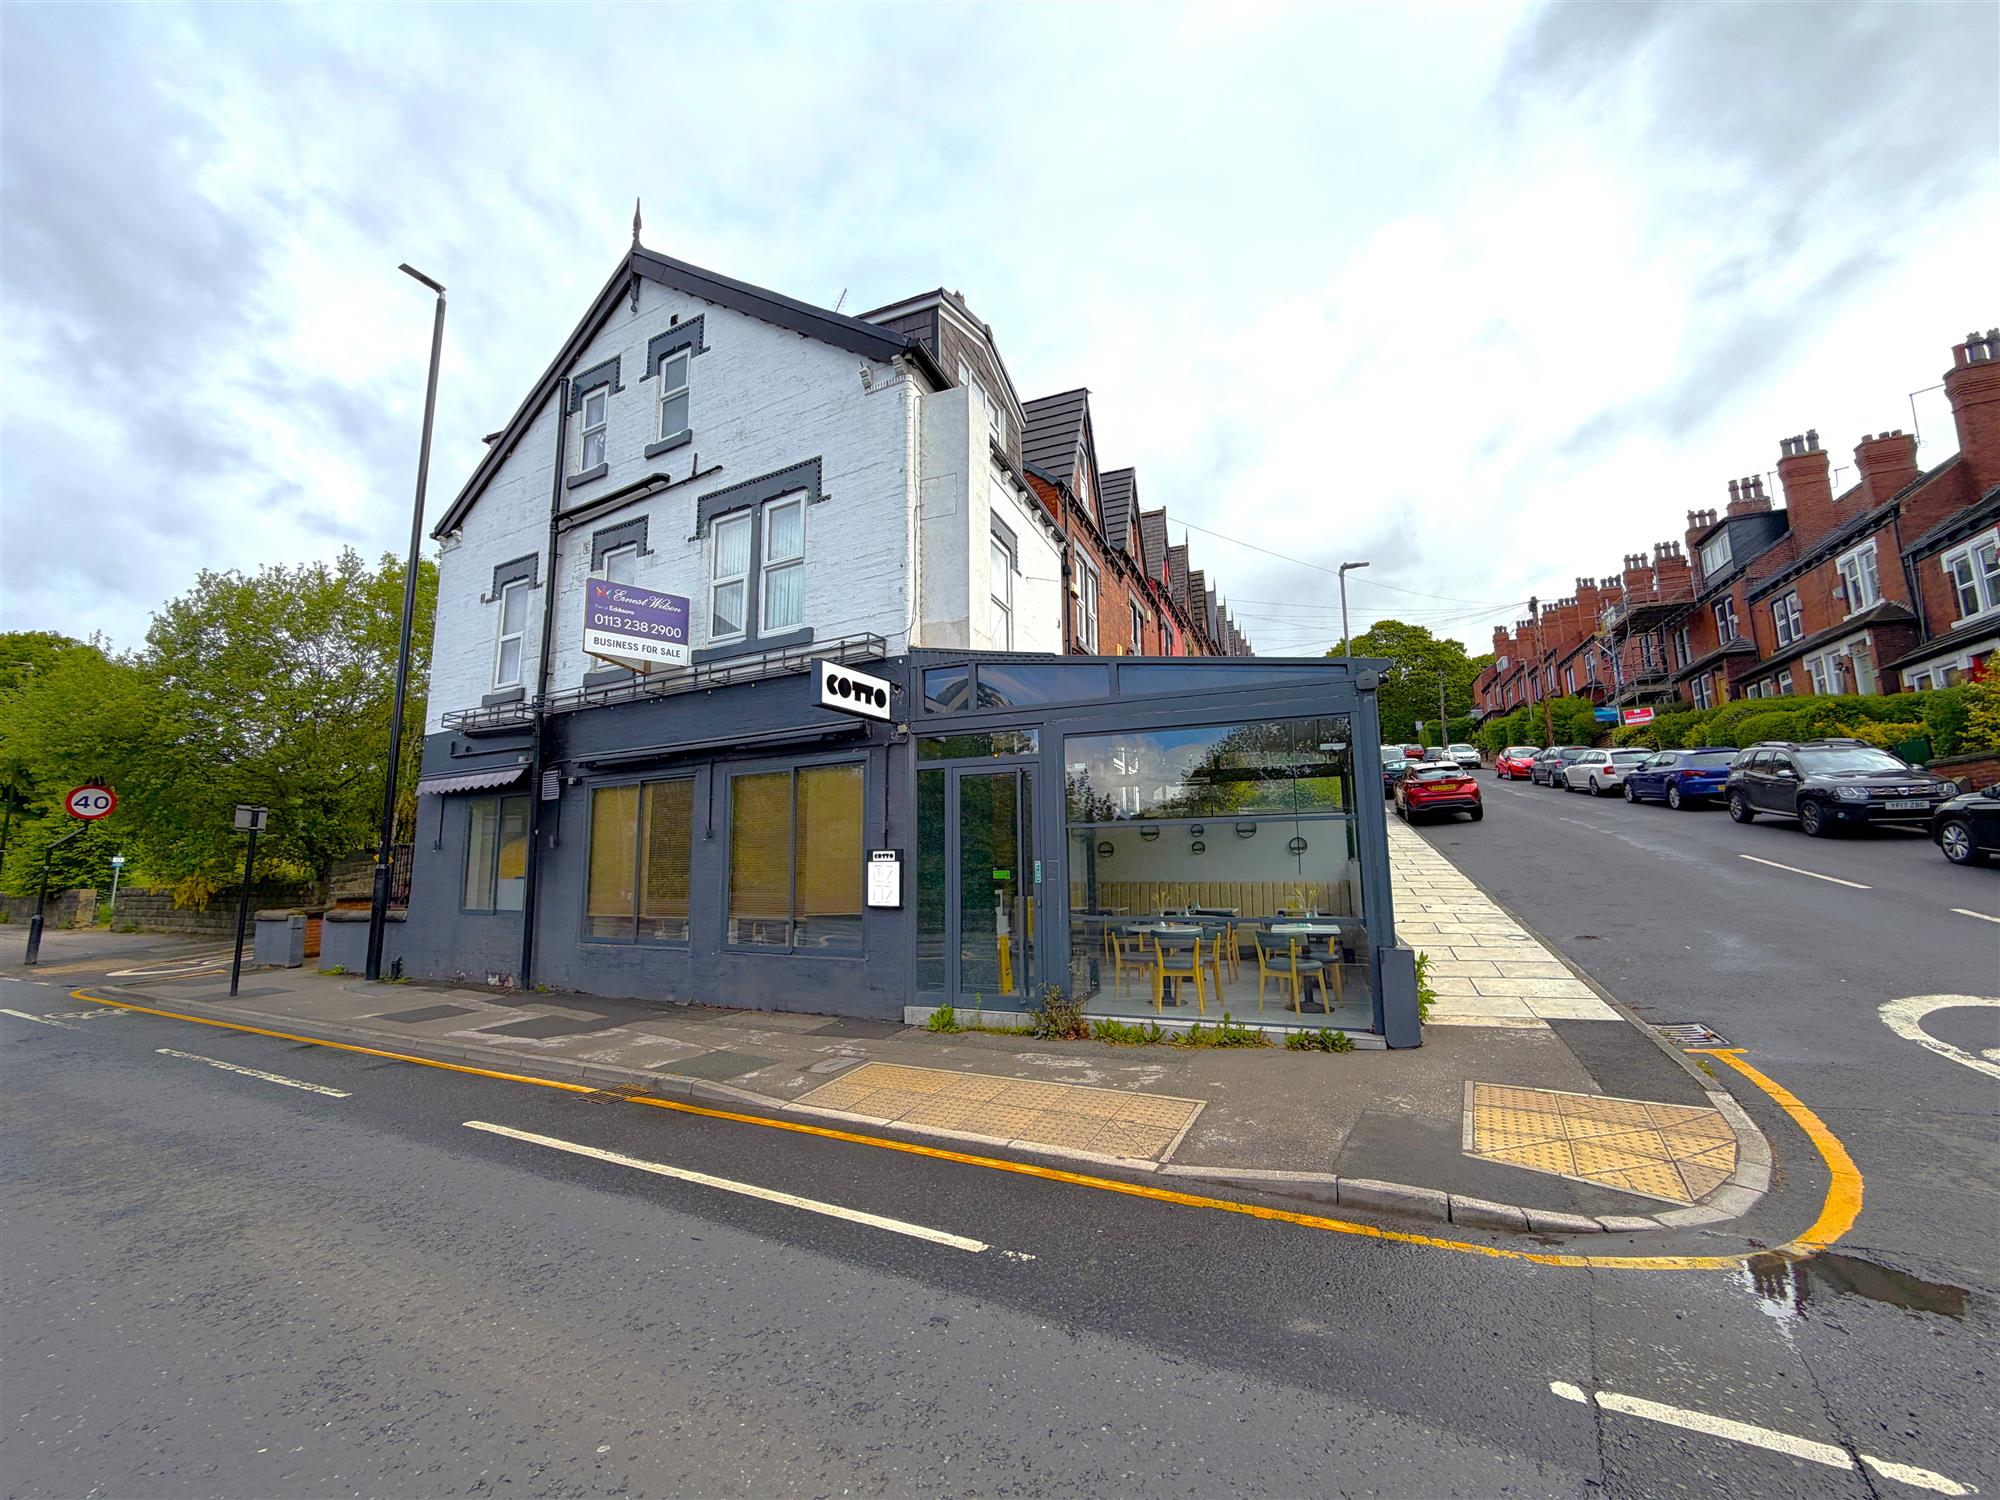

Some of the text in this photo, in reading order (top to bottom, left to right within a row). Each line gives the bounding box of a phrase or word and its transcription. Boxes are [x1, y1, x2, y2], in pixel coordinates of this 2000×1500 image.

[613, 588, 682, 613] Ernest Wilson
[594, 613, 682, 638] 0113 238 2900
[593, 636, 681, 658] BUSINESS FOR SALE
[826, 673, 887, 709] COTTO
[73, 795, 110, 809] 40
